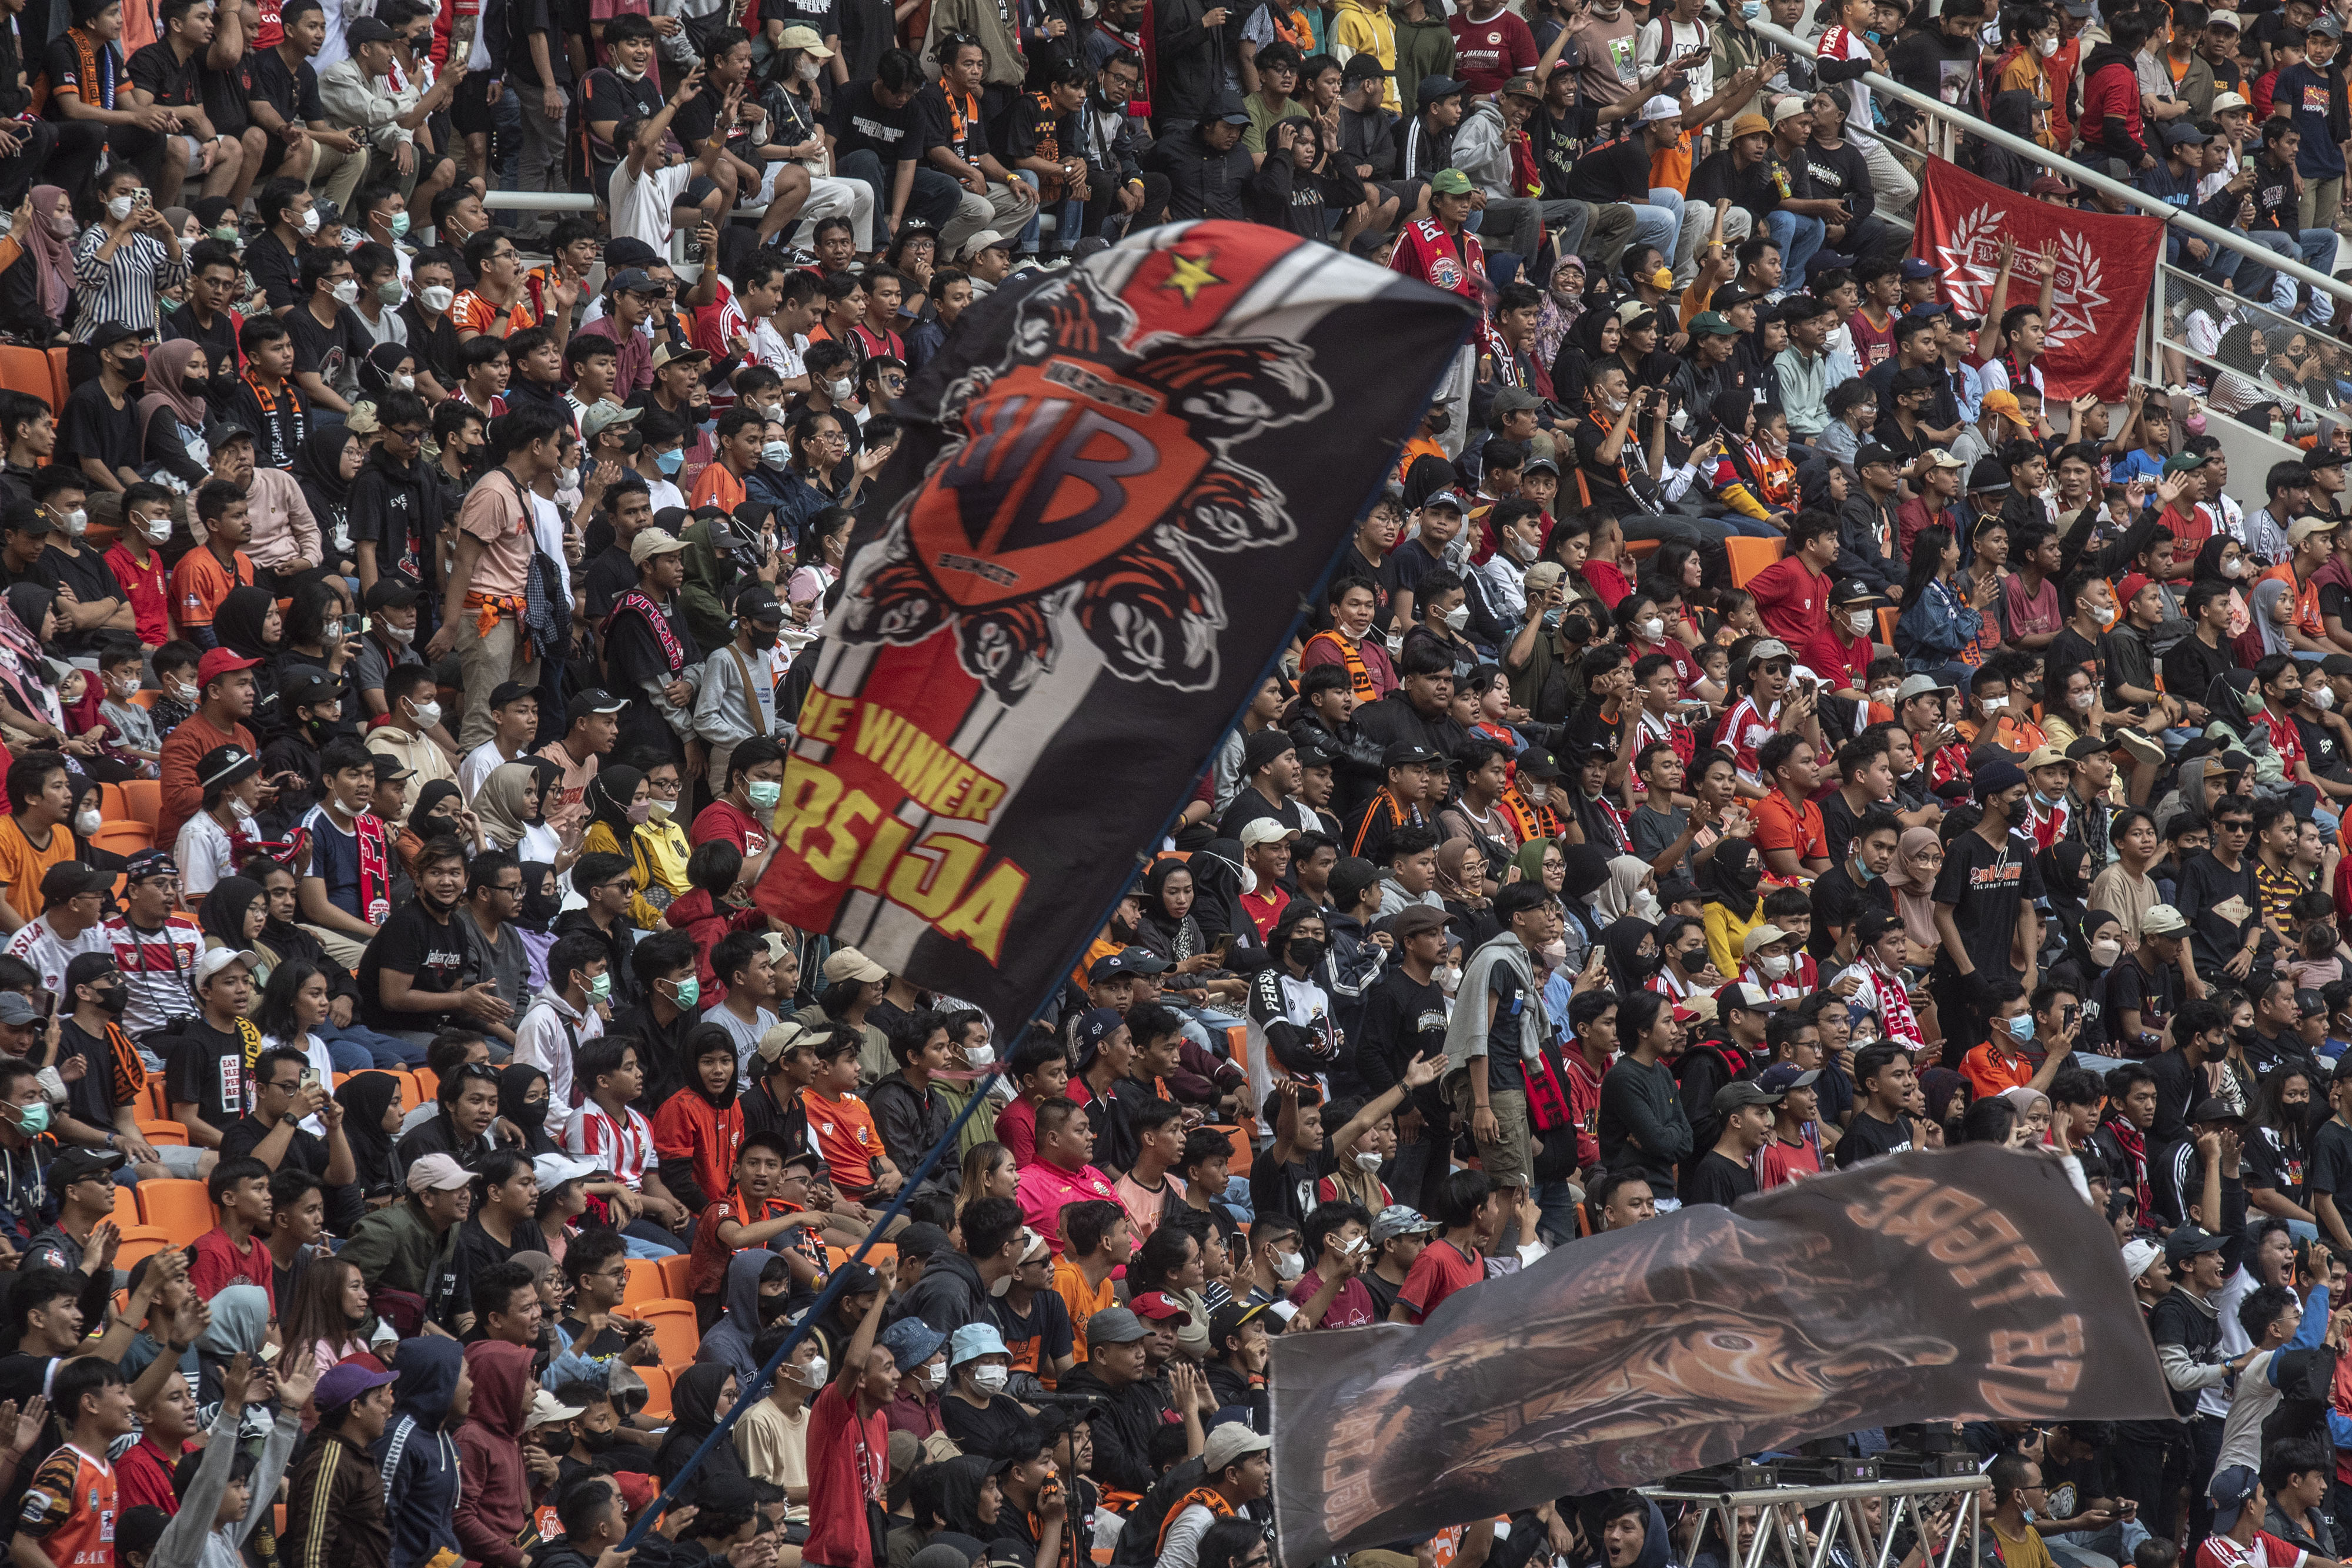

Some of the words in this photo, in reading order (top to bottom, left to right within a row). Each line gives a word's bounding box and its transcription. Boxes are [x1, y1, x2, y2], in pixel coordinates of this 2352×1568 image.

[1464, 51, 1499, 59] JAKMANIA
[626, 594, 683, 671] PERSIJA
[853, 702, 1007, 825] WINNER
[222, 1059, 236, 1068] EAT
